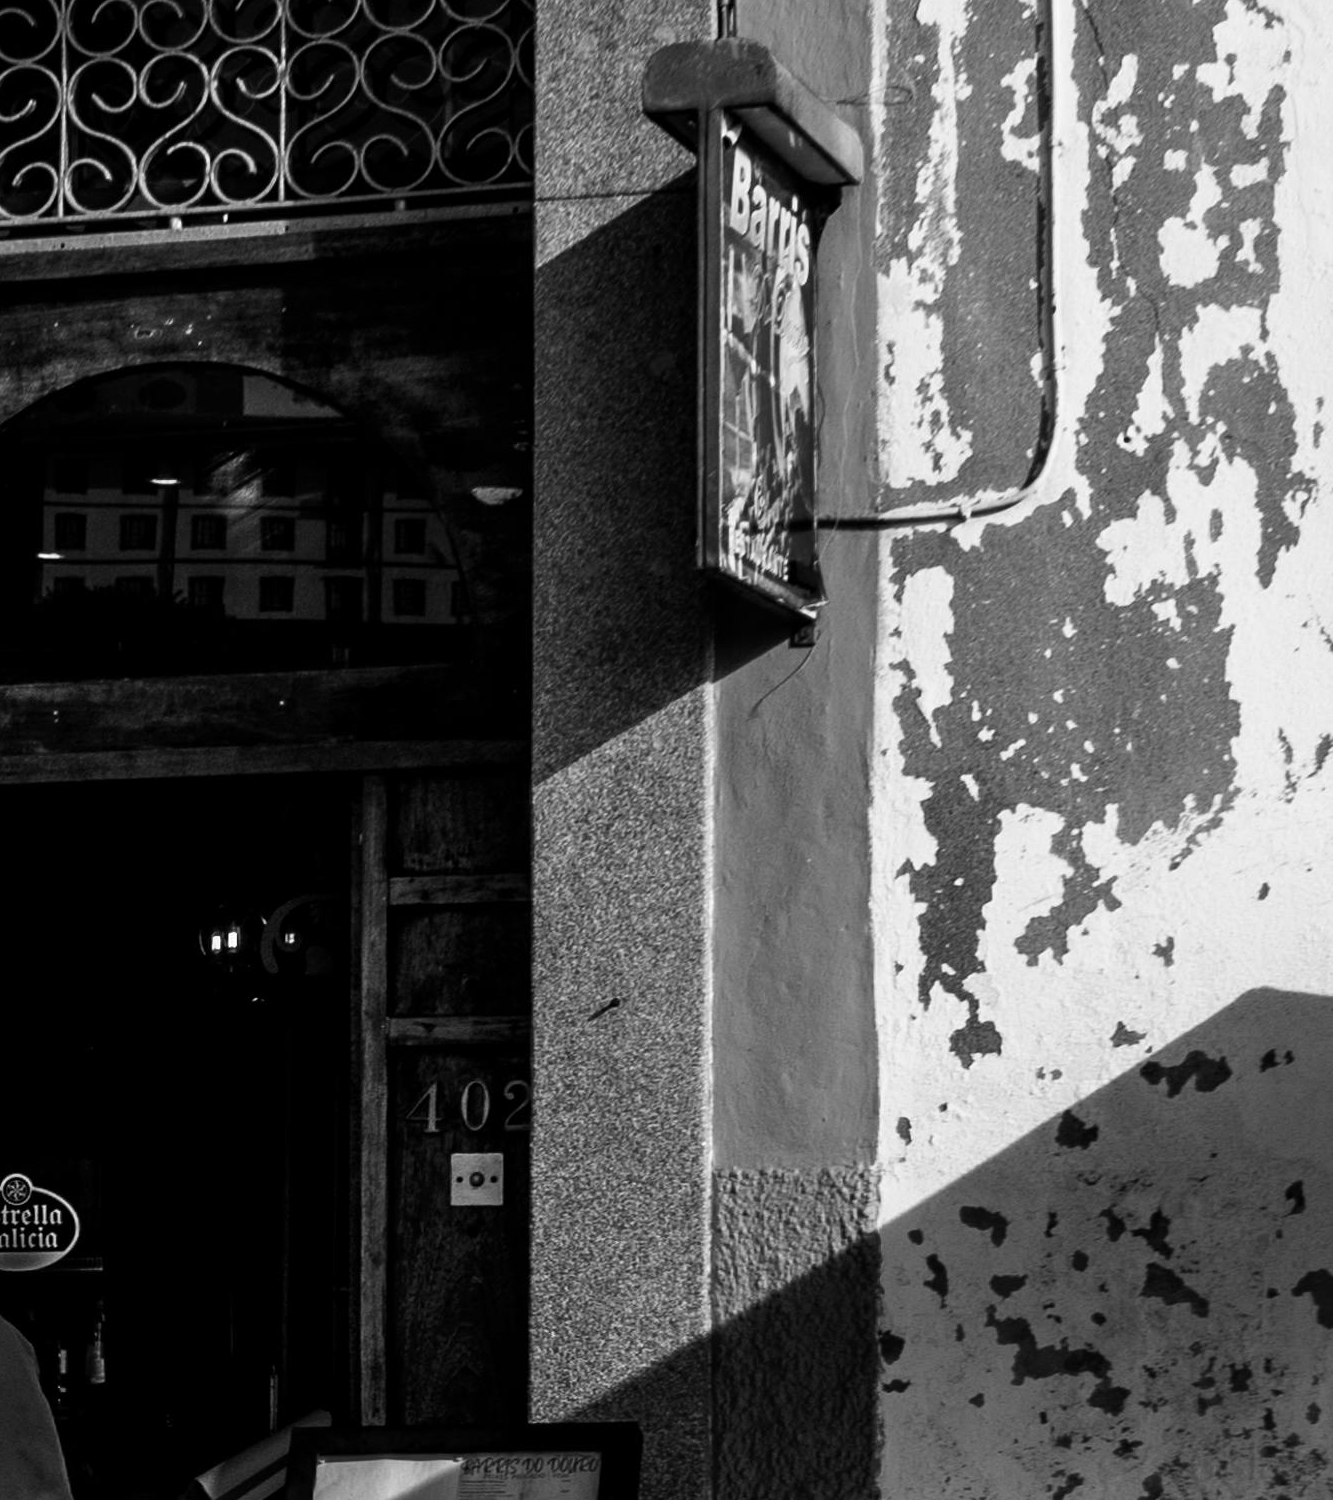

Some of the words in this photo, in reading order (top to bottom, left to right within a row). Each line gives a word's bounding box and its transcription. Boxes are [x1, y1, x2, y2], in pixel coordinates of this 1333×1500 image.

[729, 146, 810, 287] Barris
[405, 1079, 530, 1134] 402
[522, 1457, 545, 1474] DO
